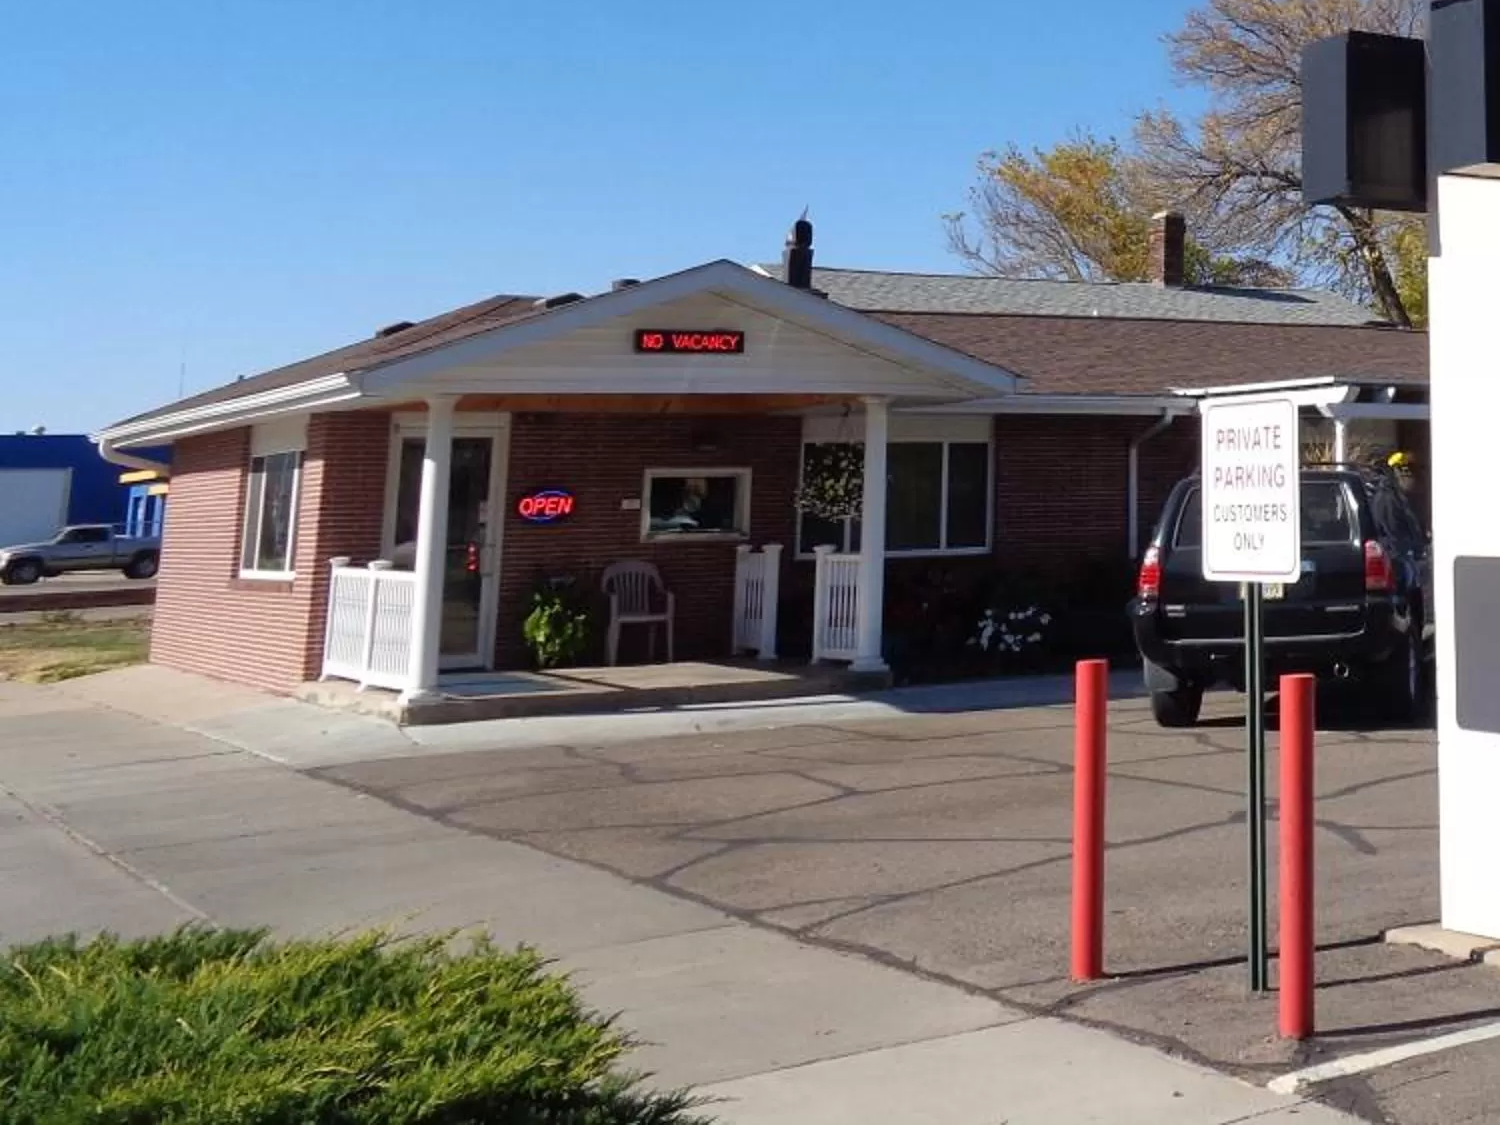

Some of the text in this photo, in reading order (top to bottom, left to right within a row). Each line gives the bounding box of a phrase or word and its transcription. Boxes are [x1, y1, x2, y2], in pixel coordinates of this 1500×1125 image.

[643, 334, 738, 350] NO VACANCY
[1216, 425, 1281, 451] PRIVATE
[1215, 463, 1286, 489] PARKING
[519, 496, 573, 517] OPEN
[1213, 504, 1287, 523] CUSTOMERS
[1233, 532, 1265, 551] ONLY
